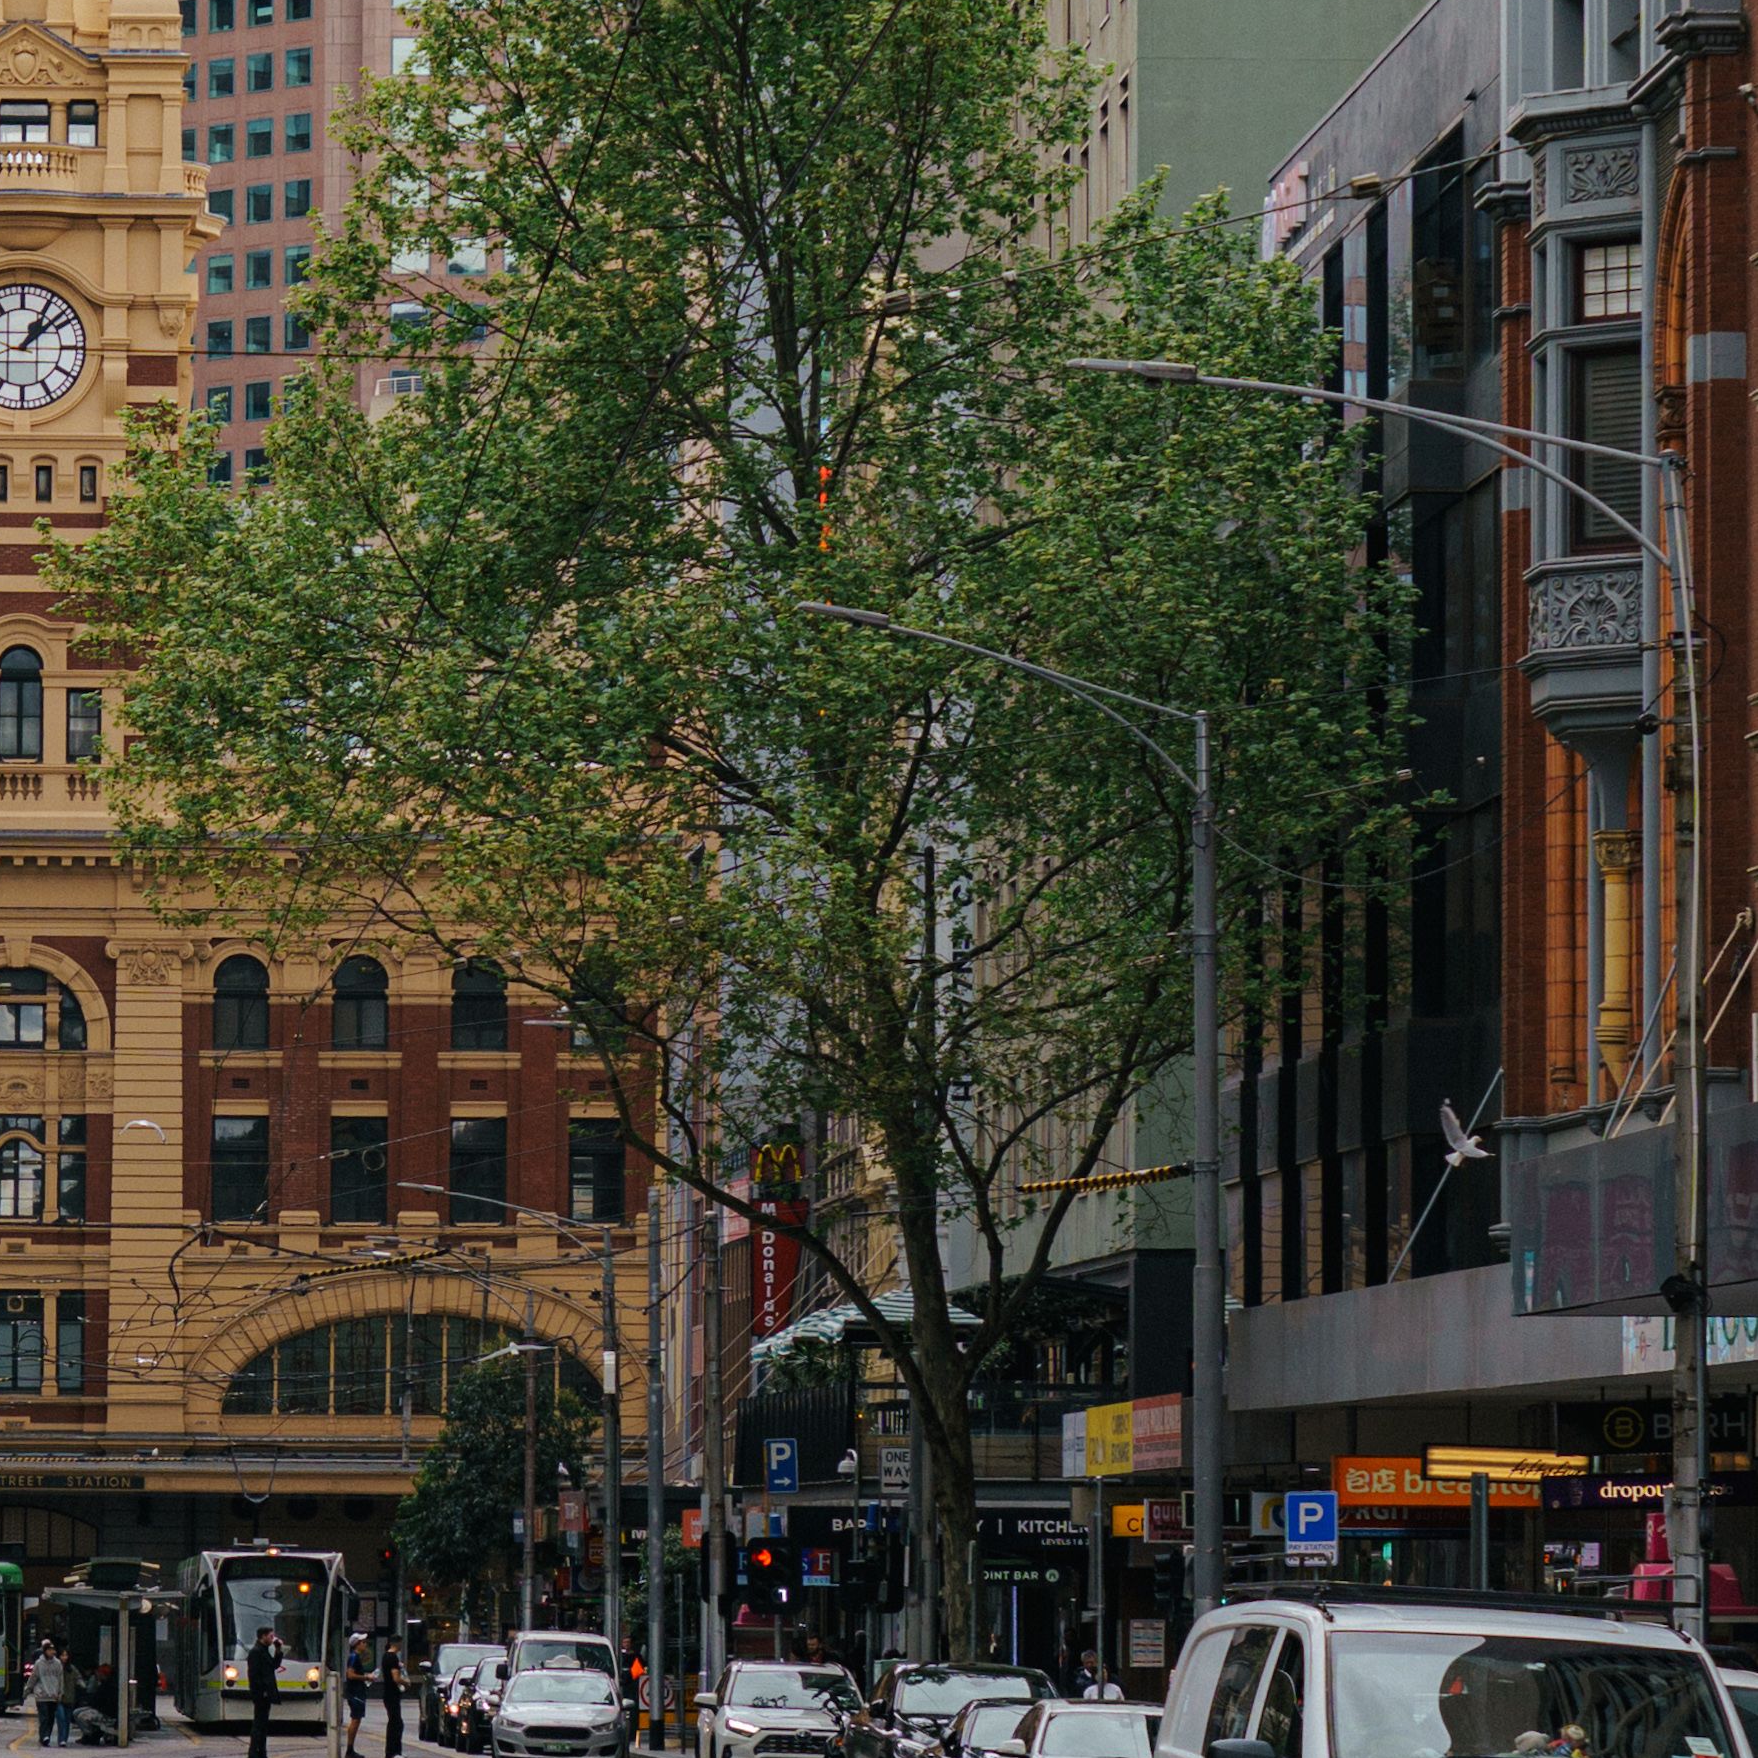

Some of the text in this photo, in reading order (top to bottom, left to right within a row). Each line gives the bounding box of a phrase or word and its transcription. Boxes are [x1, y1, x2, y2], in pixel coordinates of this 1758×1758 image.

[761, 1202, 780, 1327] MDonald's
[885, 1451, 910, 1463] ONE
[884, 1466, 911, 1477] WAY
[66, 1475, 131, 1487] STATION
[1346, 1468, 1397, 1493] 包店
[1404, 1469, 1542, 1500] breatop
[1304, 1544, 1335, 1552] STATION
[1013, 1571, 1039, 1580] BAR
